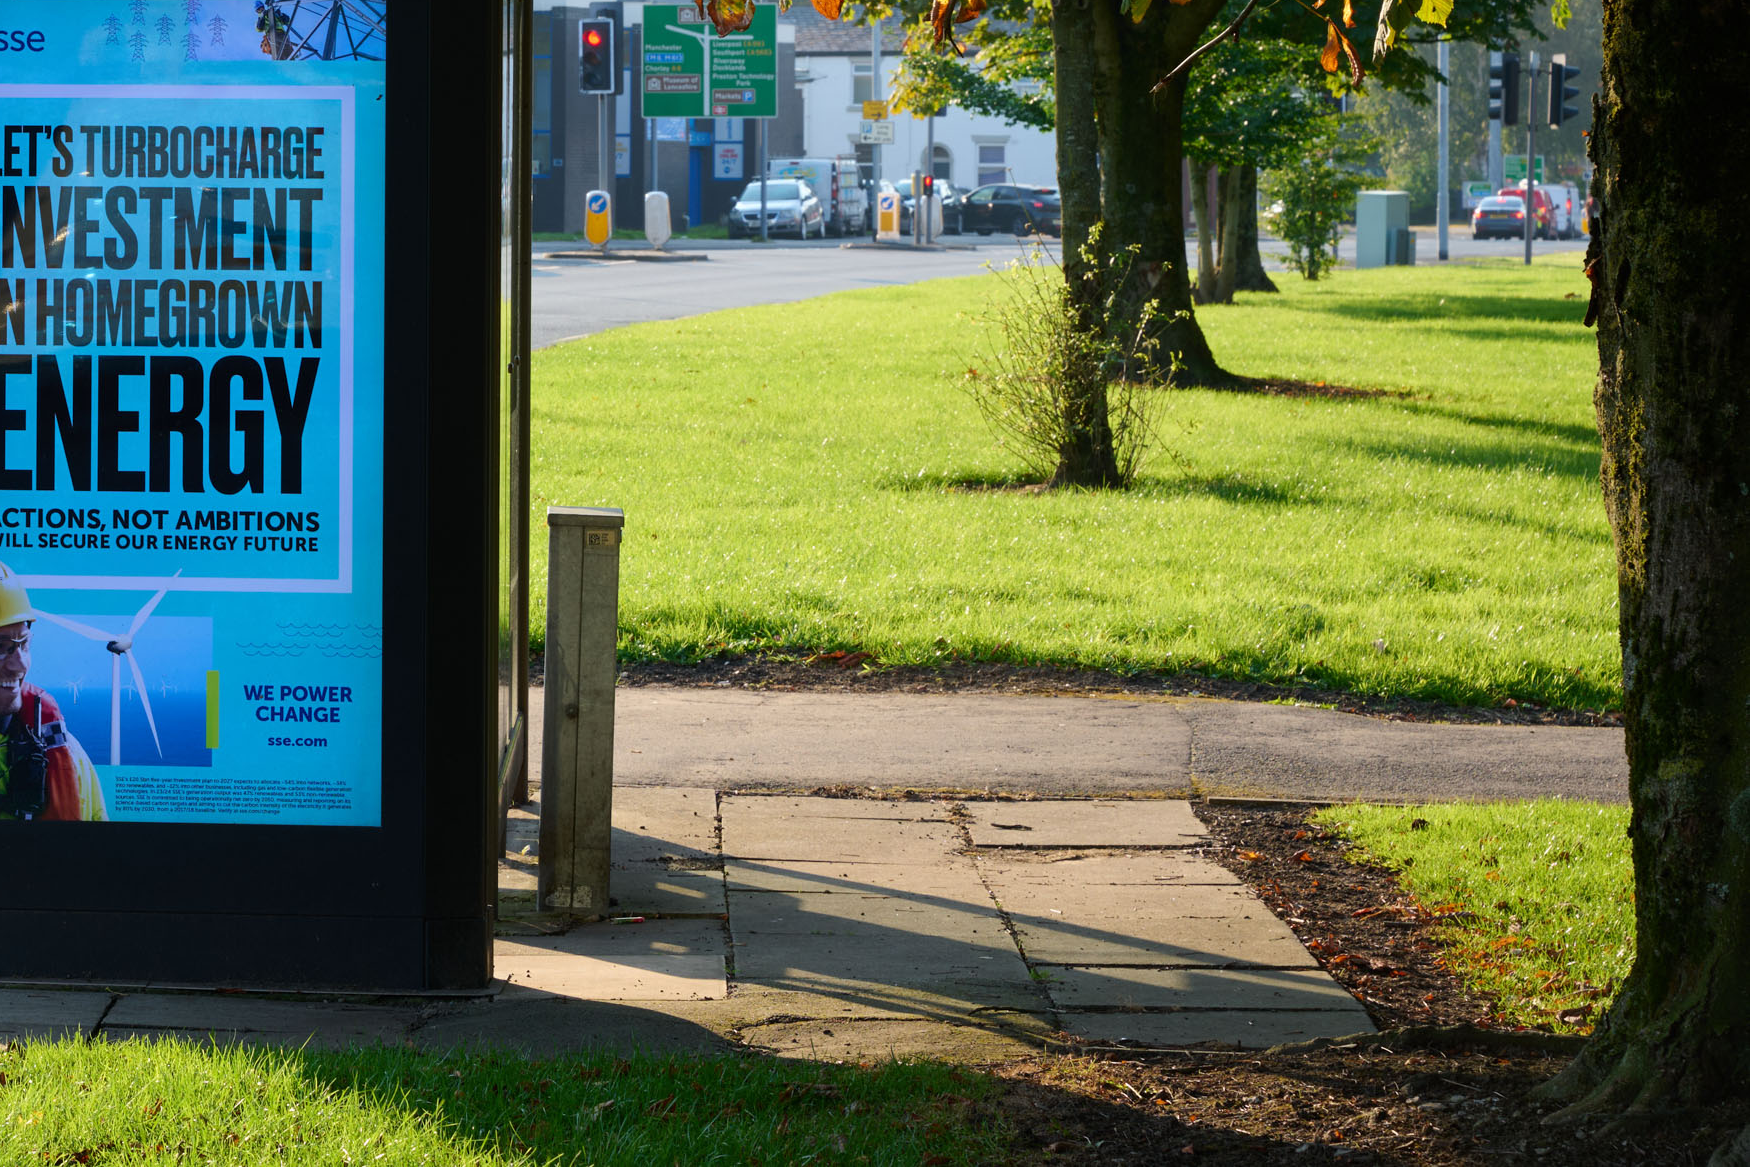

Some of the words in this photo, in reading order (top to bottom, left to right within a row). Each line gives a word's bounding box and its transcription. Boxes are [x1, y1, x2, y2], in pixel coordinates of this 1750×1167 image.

[645, 44, 683, 52] Manchester
[713, 40, 742, 48] Liverpool
[713, 49, 745, 57] Southport
[645, 65, 670, 73] Chorley
[713, 64, 746, 72] Docklands
[738, 73, 774, 81] Technology
[714, 92, 742, 100] Markets
[80, 125, 325, 180] TURBOCHARGE
[36, 278, 323, 348] HOMEGROWN
[113, 509, 169, 530] NOT
[175, 510, 321, 532] AMBITIONS
[38, 533, 110, 549] SECURE
[115, 535, 160, 550] OUR
[163, 536, 238, 551] ENERGY
[243, 536, 319, 552] FUTURE
[243, 684, 275, 701] WE
[280, 685, 353, 703] POWER
[255, 705, 341, 723] CHANGE
[267, 737, 328, 747] sse.com
